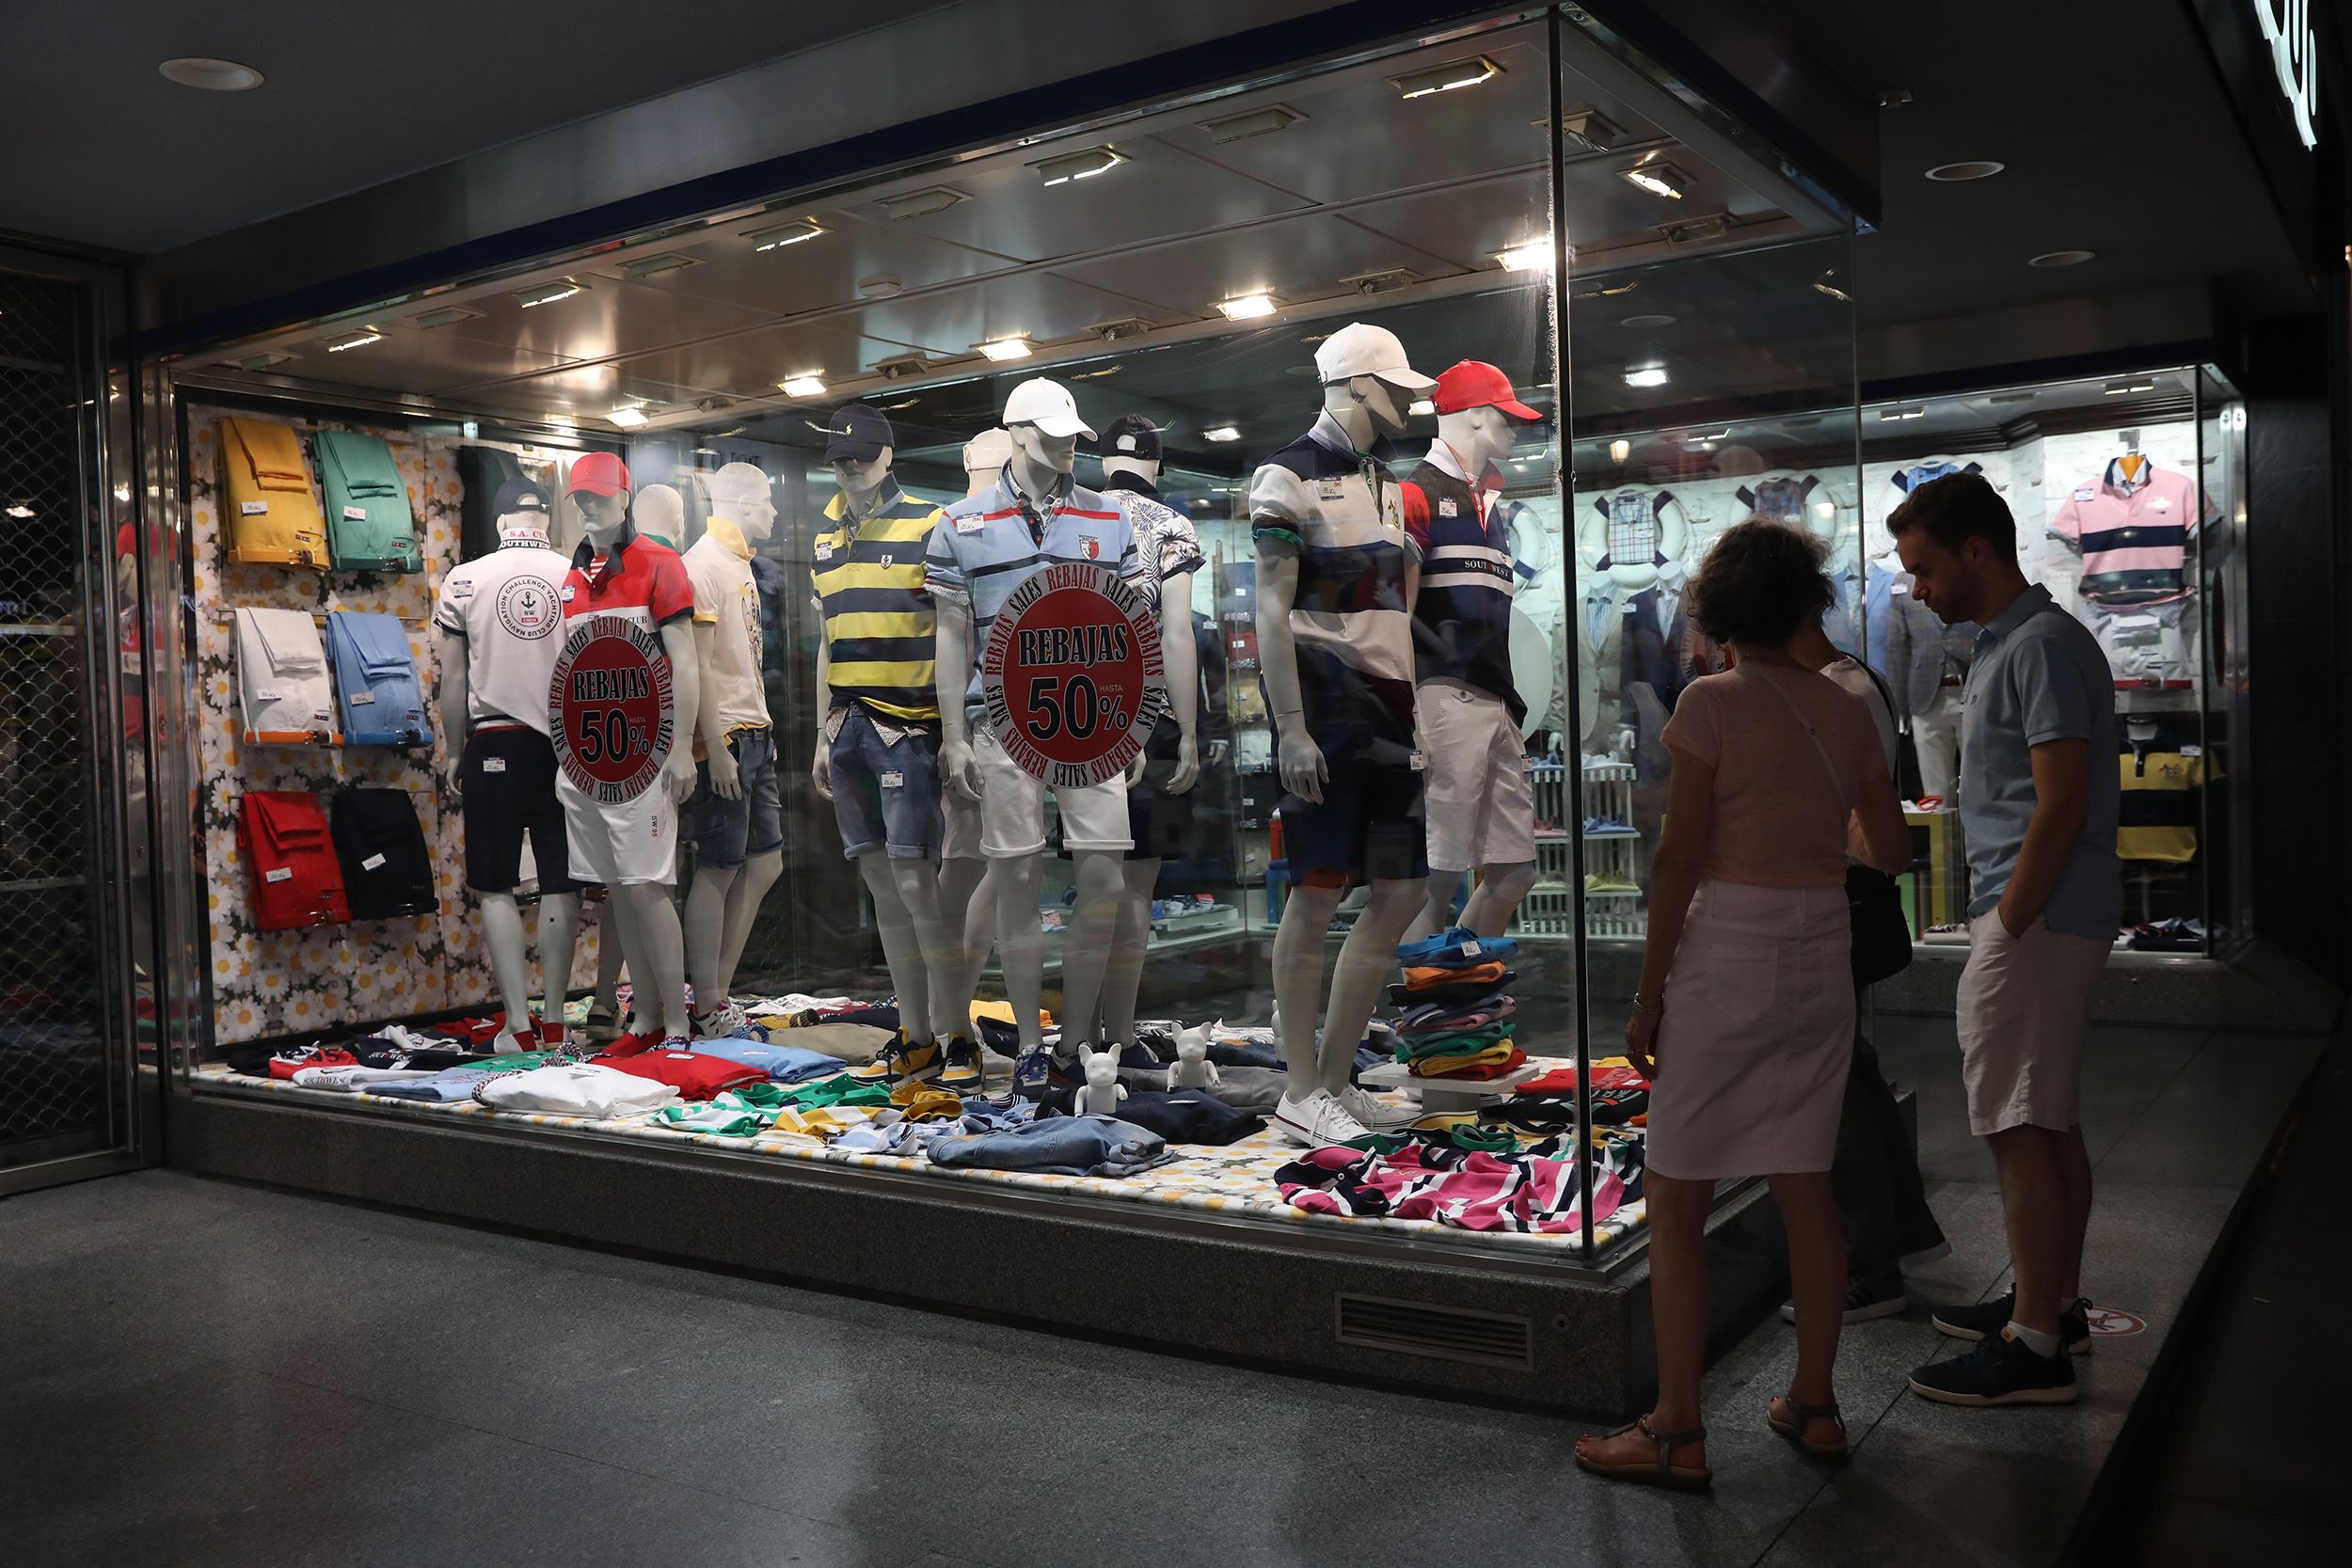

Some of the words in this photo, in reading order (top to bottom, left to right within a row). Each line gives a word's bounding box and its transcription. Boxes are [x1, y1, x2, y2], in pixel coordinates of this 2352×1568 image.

[505, 579, 547, 594] CHALLENGE
[1009, 577, 1042, 616] SALES
[1045, 564, 1099, 591] REBAJAS
[1103, 575, 1137, 613] SALES
[501, 595, 526, 636] NAVIGATION
[546, 590, 558, 630] YACHTING
[591, 617, 628, 638] REBAJAS
[527, 627, 546, 637] CLUB
[565, 627, 590, 659] SALES
[630, 626, 656, 658] SALES
[985, 613, 1015, 675] REBAJAS
[1018, 624, 1128, 668] REBAJAS
[1131, 611, 1165, 676] REBAJAS
[549, 657, 570, 709] REBAJAS
[573, 667, 649, 703] REBAJAS
[651, 656, 674, 710] REBAJAS
[985, 684, 1009, 727] SALES
[1026, 674, 1129, 741] 50%
[1136, 686, 1163, 731] SALES
[550, 717, 567, 752] SALES
[580, 707, 650, 764] 50%
[655, 718, 674, 754] SALES
[1001, 727, 1048, 780] REBAJAS
[563, 752, 595, 795] REBAJAS
[625, 758, 660, 797] REBAJAS
[1054, 763, 1088, 786] SALES
[1091, 734, 1142, 782] REBAJAS
[598, 782, 623, 801] SALES
